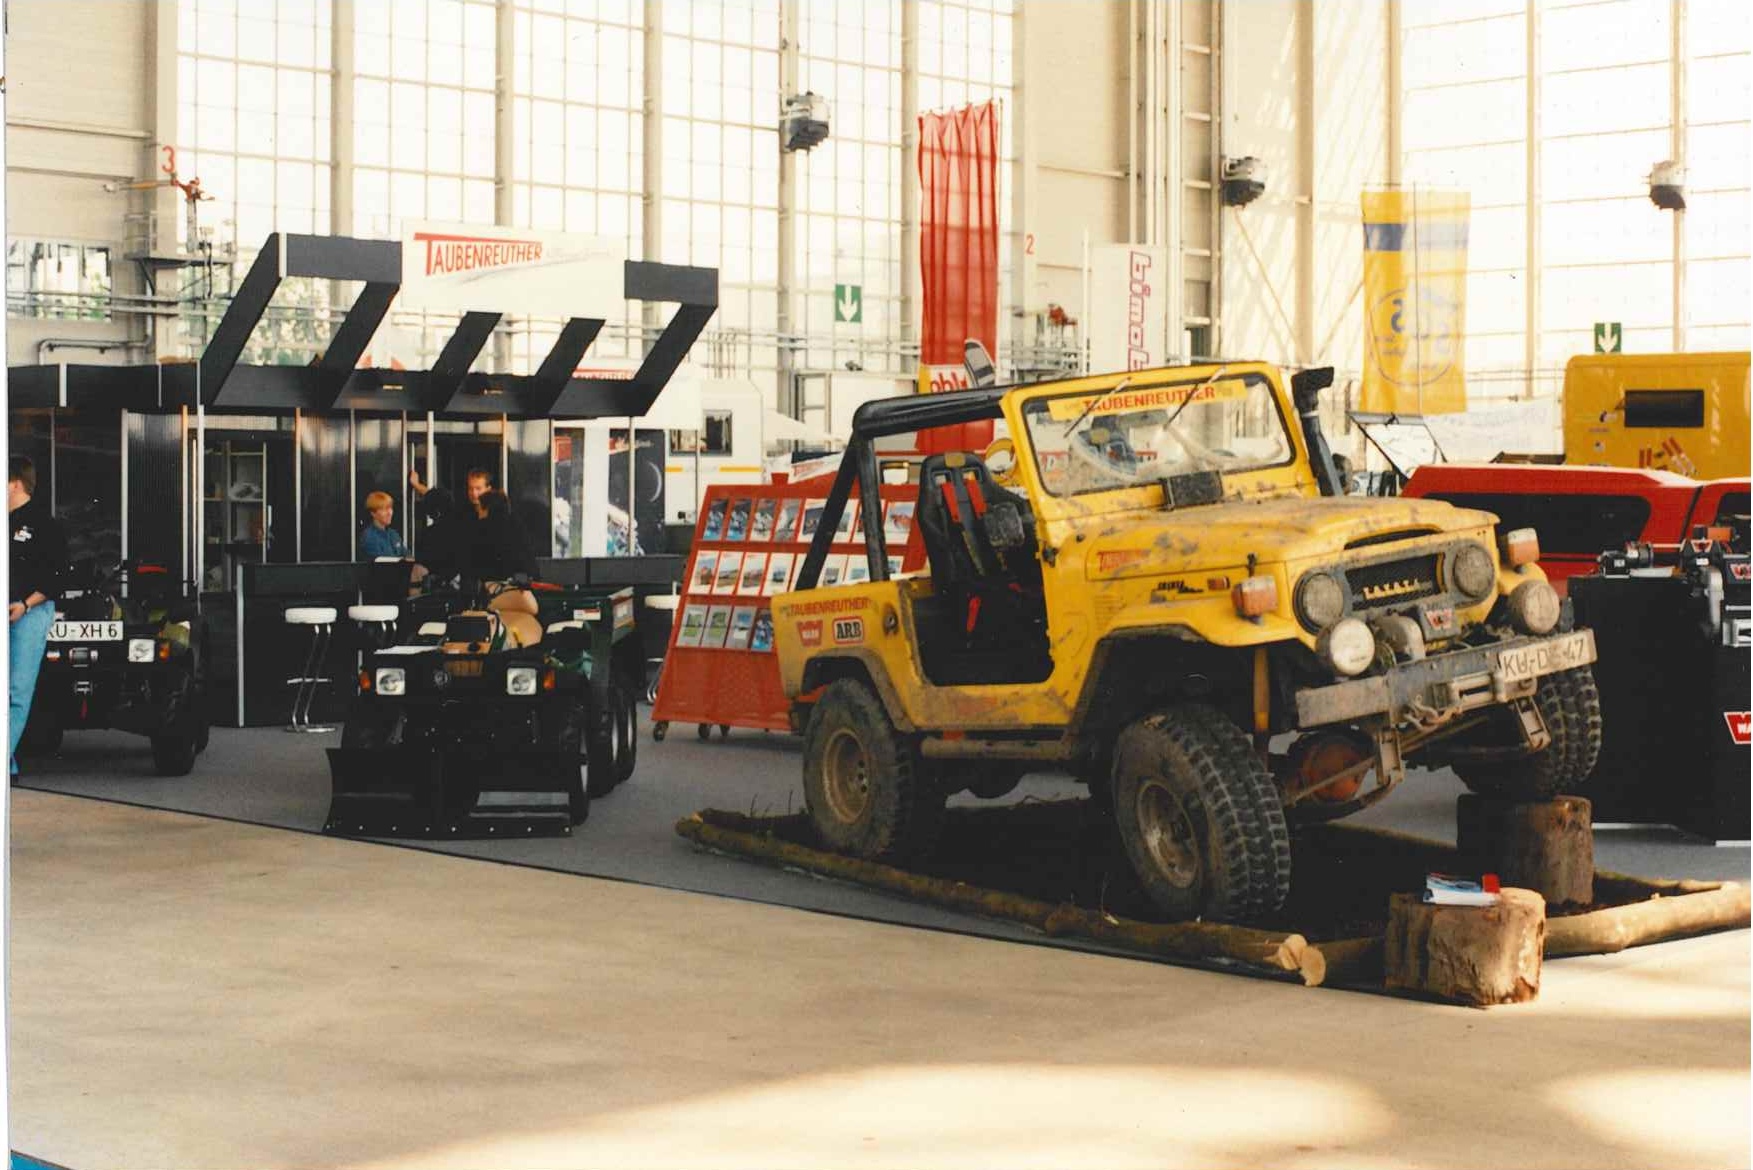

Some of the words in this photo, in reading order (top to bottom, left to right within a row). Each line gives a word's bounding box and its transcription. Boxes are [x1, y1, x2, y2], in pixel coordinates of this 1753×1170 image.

[162, 145, 175, 173] 3
[414, 232, 543, 276] TAUBENREUTHER
[1026, 234, 1035, 255] 2
[108, 623, 117, 638] 6
[836, 622, 862, 640] ARB
